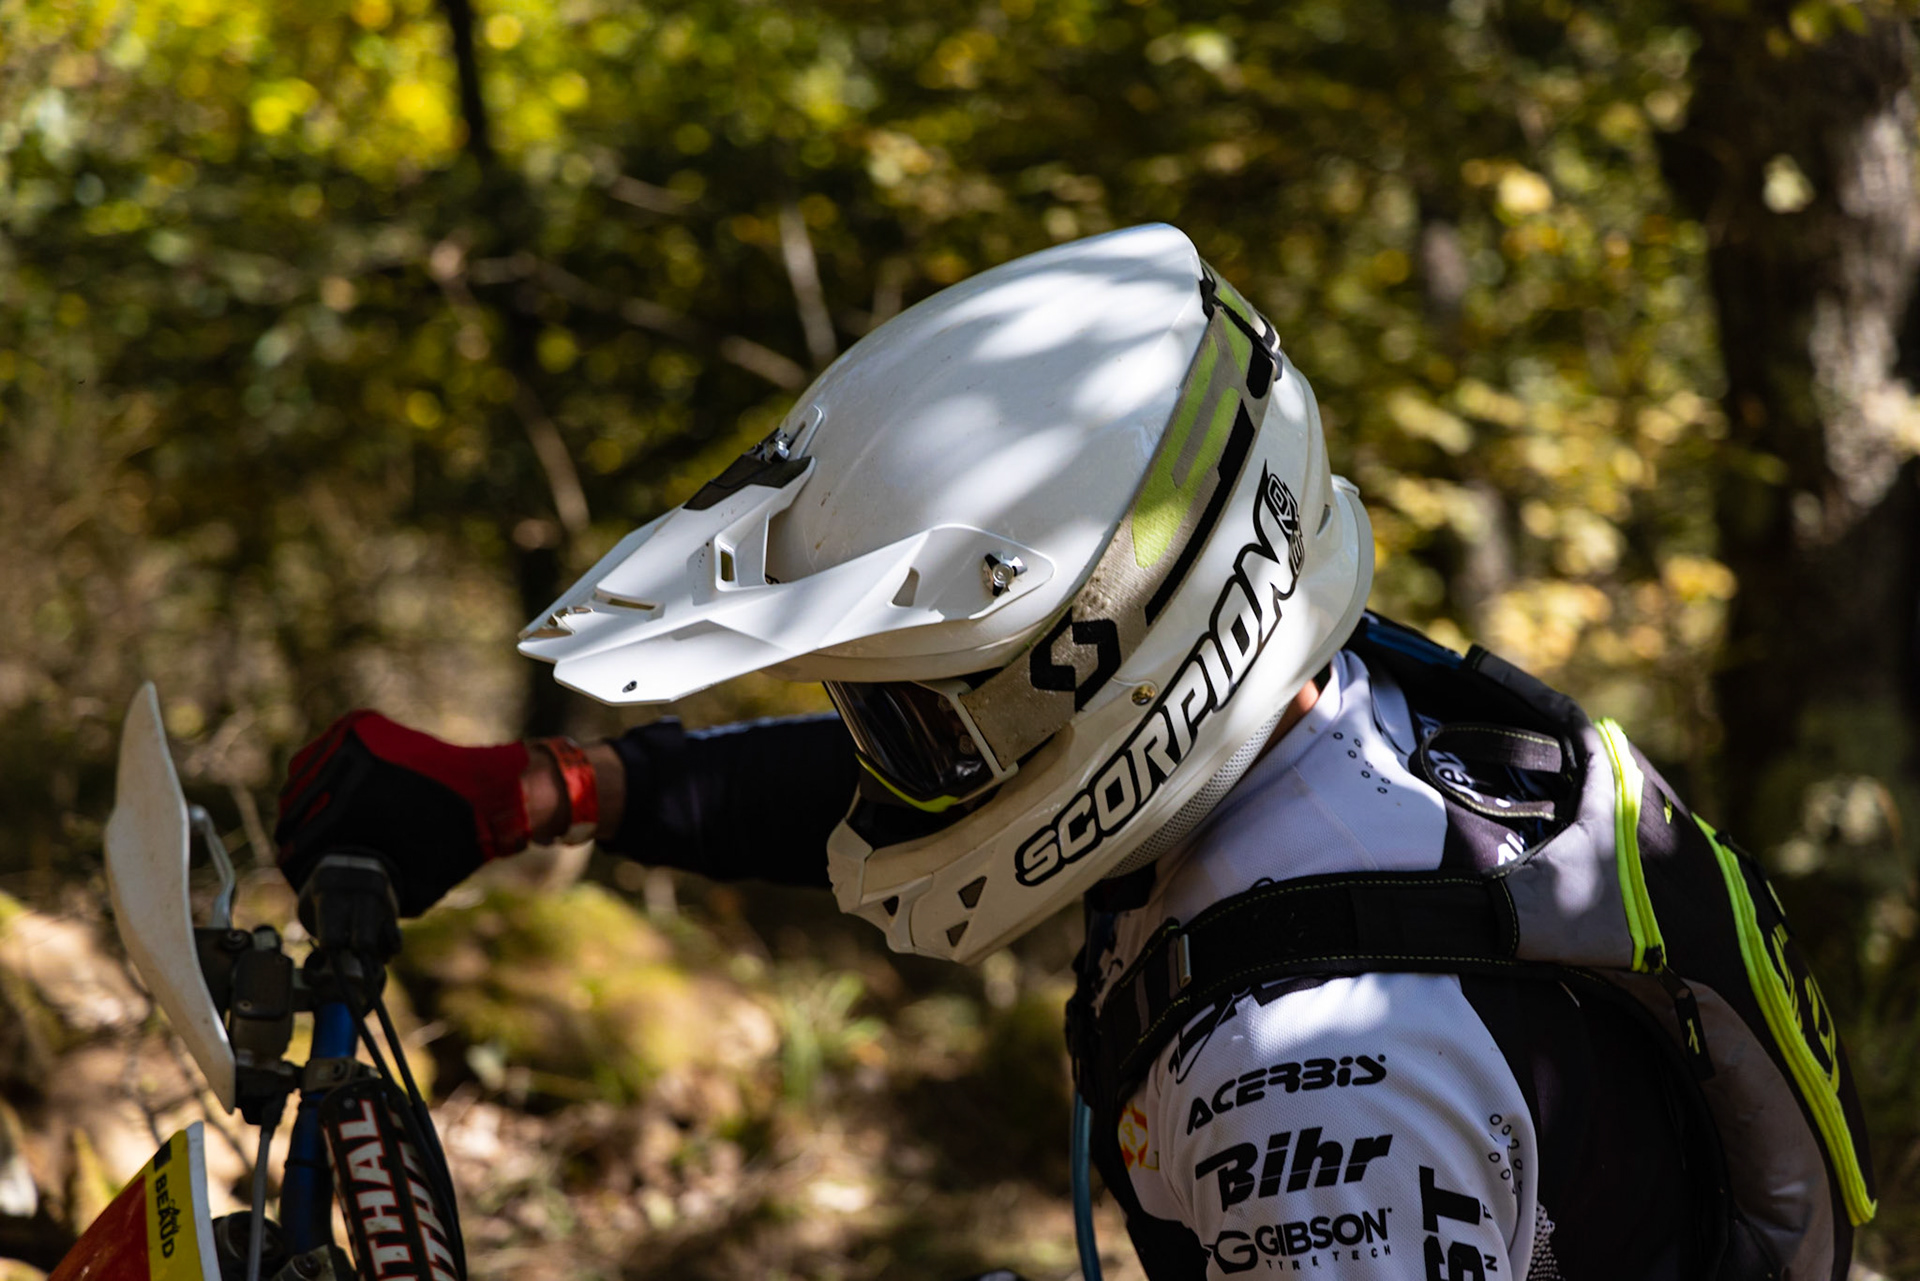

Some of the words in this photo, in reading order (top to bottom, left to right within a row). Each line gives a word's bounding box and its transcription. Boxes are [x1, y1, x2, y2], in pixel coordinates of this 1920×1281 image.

[1014, 458, 1297, 888] SCORPION
[1186, 1055, 1387, 1136] ACERBIS
[339, 1099, 419, 1281] THAL
[1195, 1126, 1393, 1212] Bihr
[1255, 1208, 1388, 1256] GIBSON
